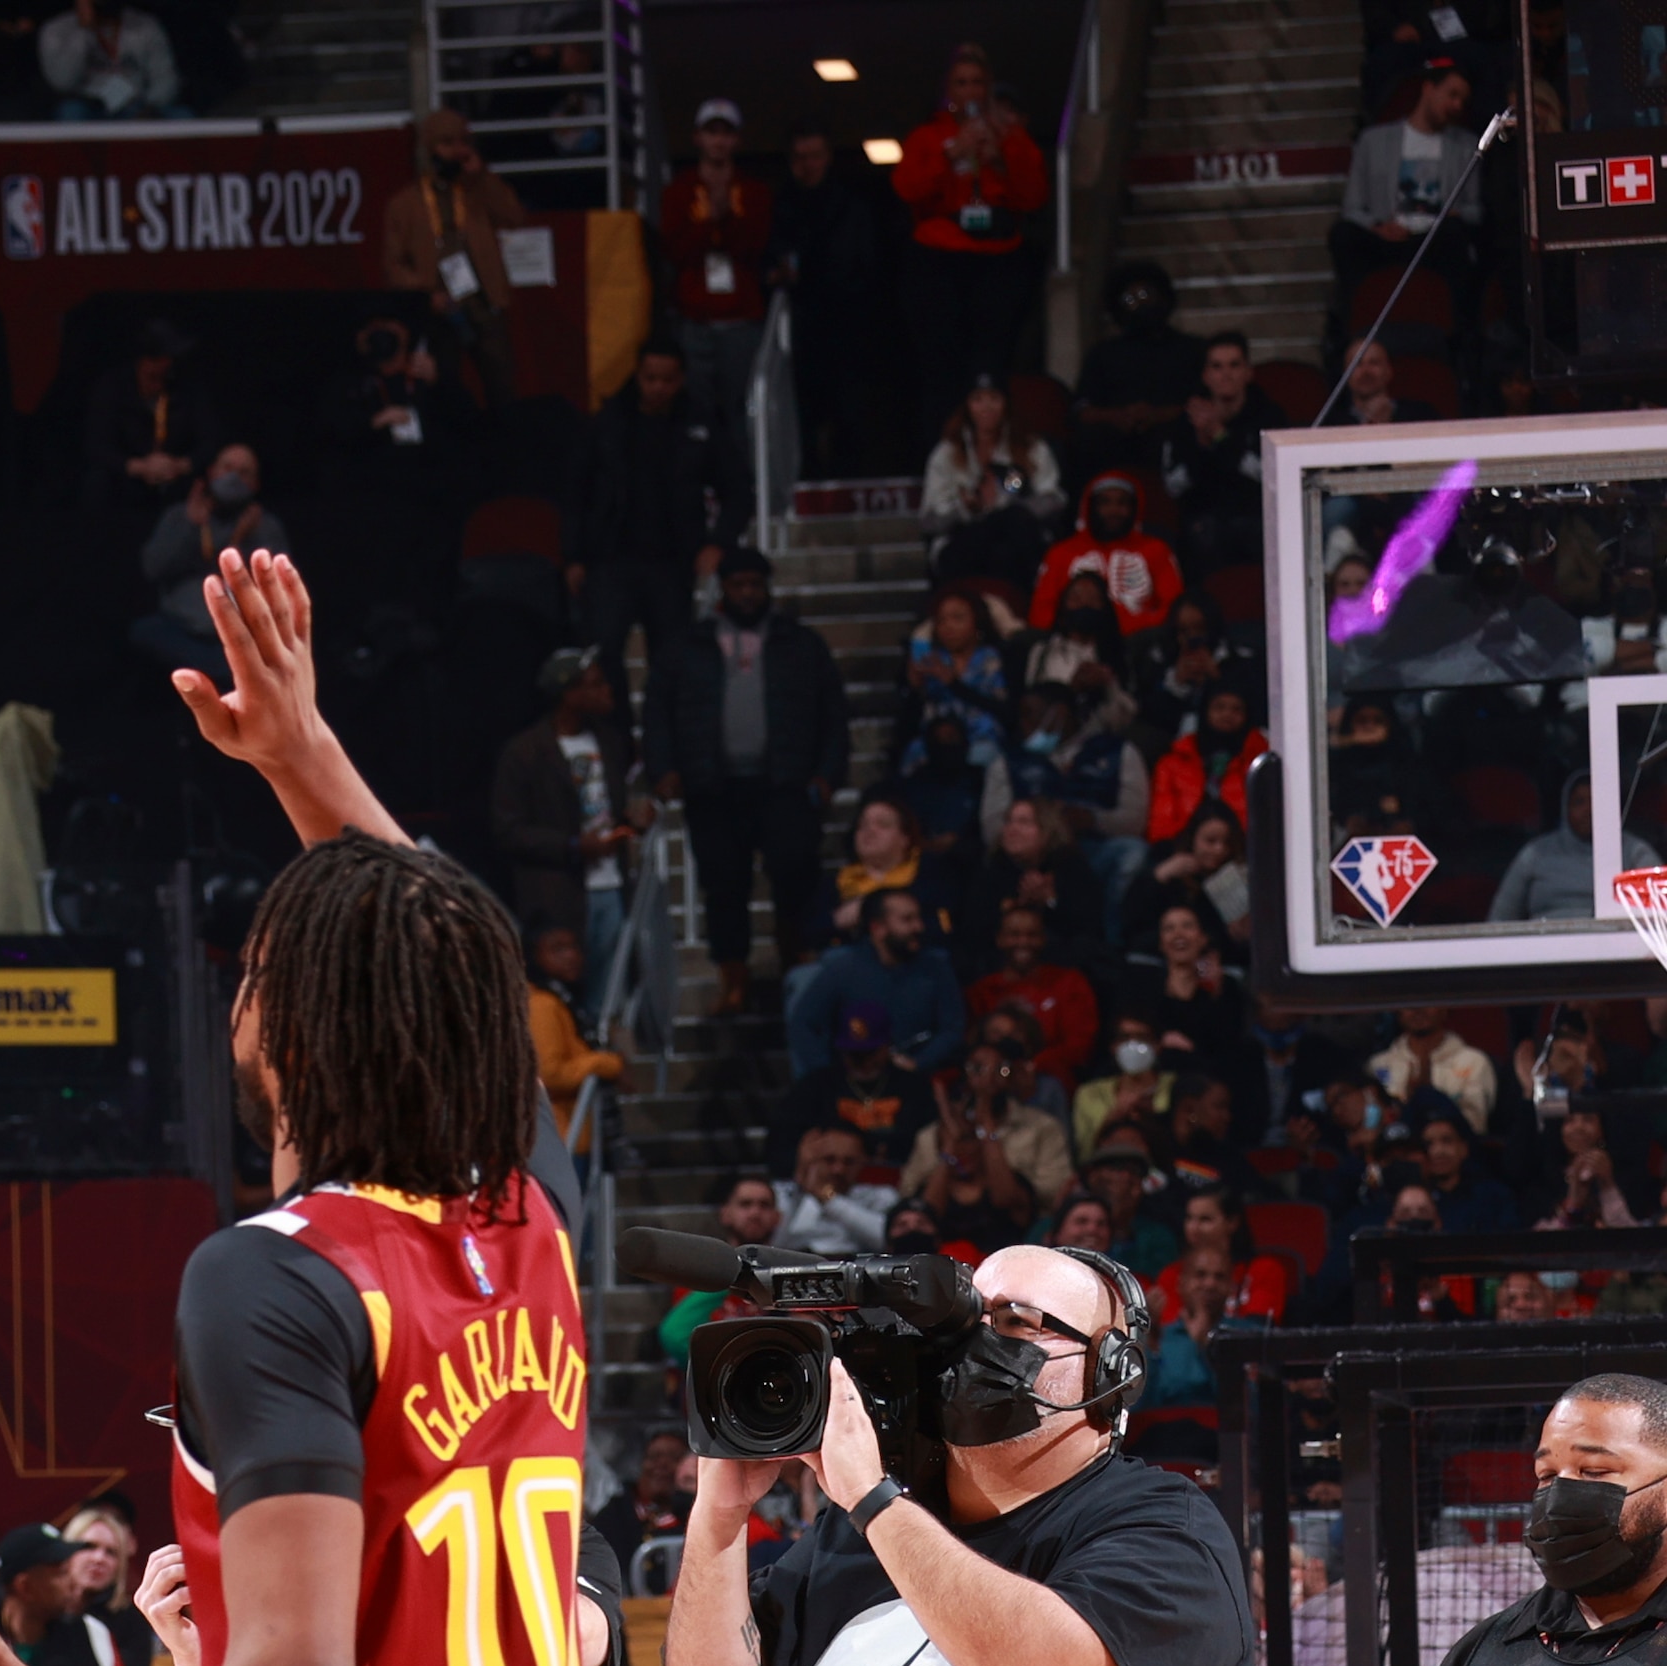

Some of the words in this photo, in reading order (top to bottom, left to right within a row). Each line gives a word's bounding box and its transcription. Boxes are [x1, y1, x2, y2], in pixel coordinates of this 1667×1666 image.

[1194, 152, 1281, 183] M101
[257, 168, 364, 248] 2022
[1391, 847, 1414, 879] 75
[773, 1266, 802, 1274] SONY
